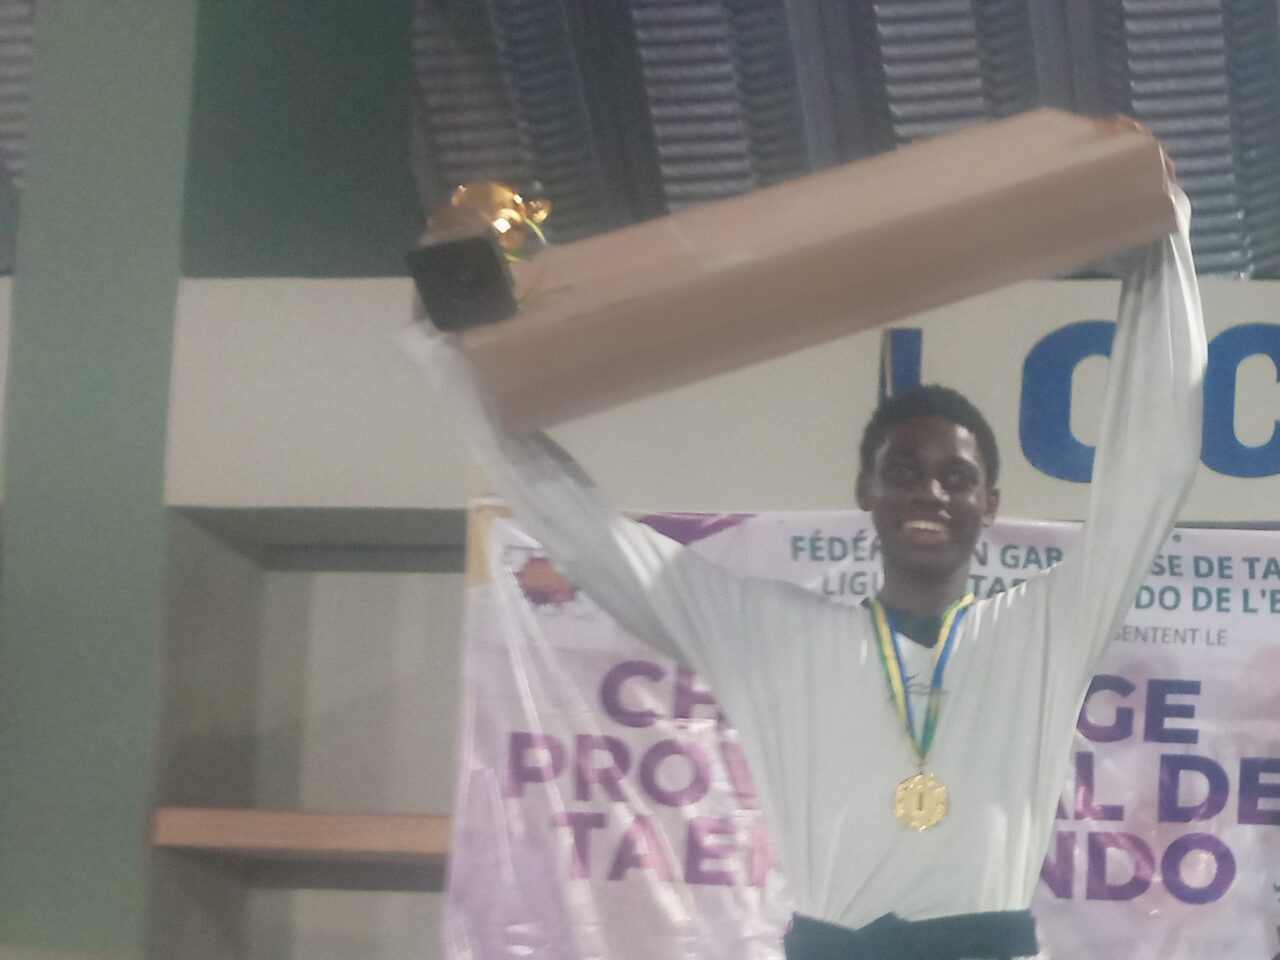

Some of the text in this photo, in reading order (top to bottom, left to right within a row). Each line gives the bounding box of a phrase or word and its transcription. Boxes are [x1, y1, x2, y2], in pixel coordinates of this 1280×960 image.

[1193, 555, 1233, 579] DE
[1192, 586, 1231, 613] DE
[1205, 628, 1228, 646] LE
